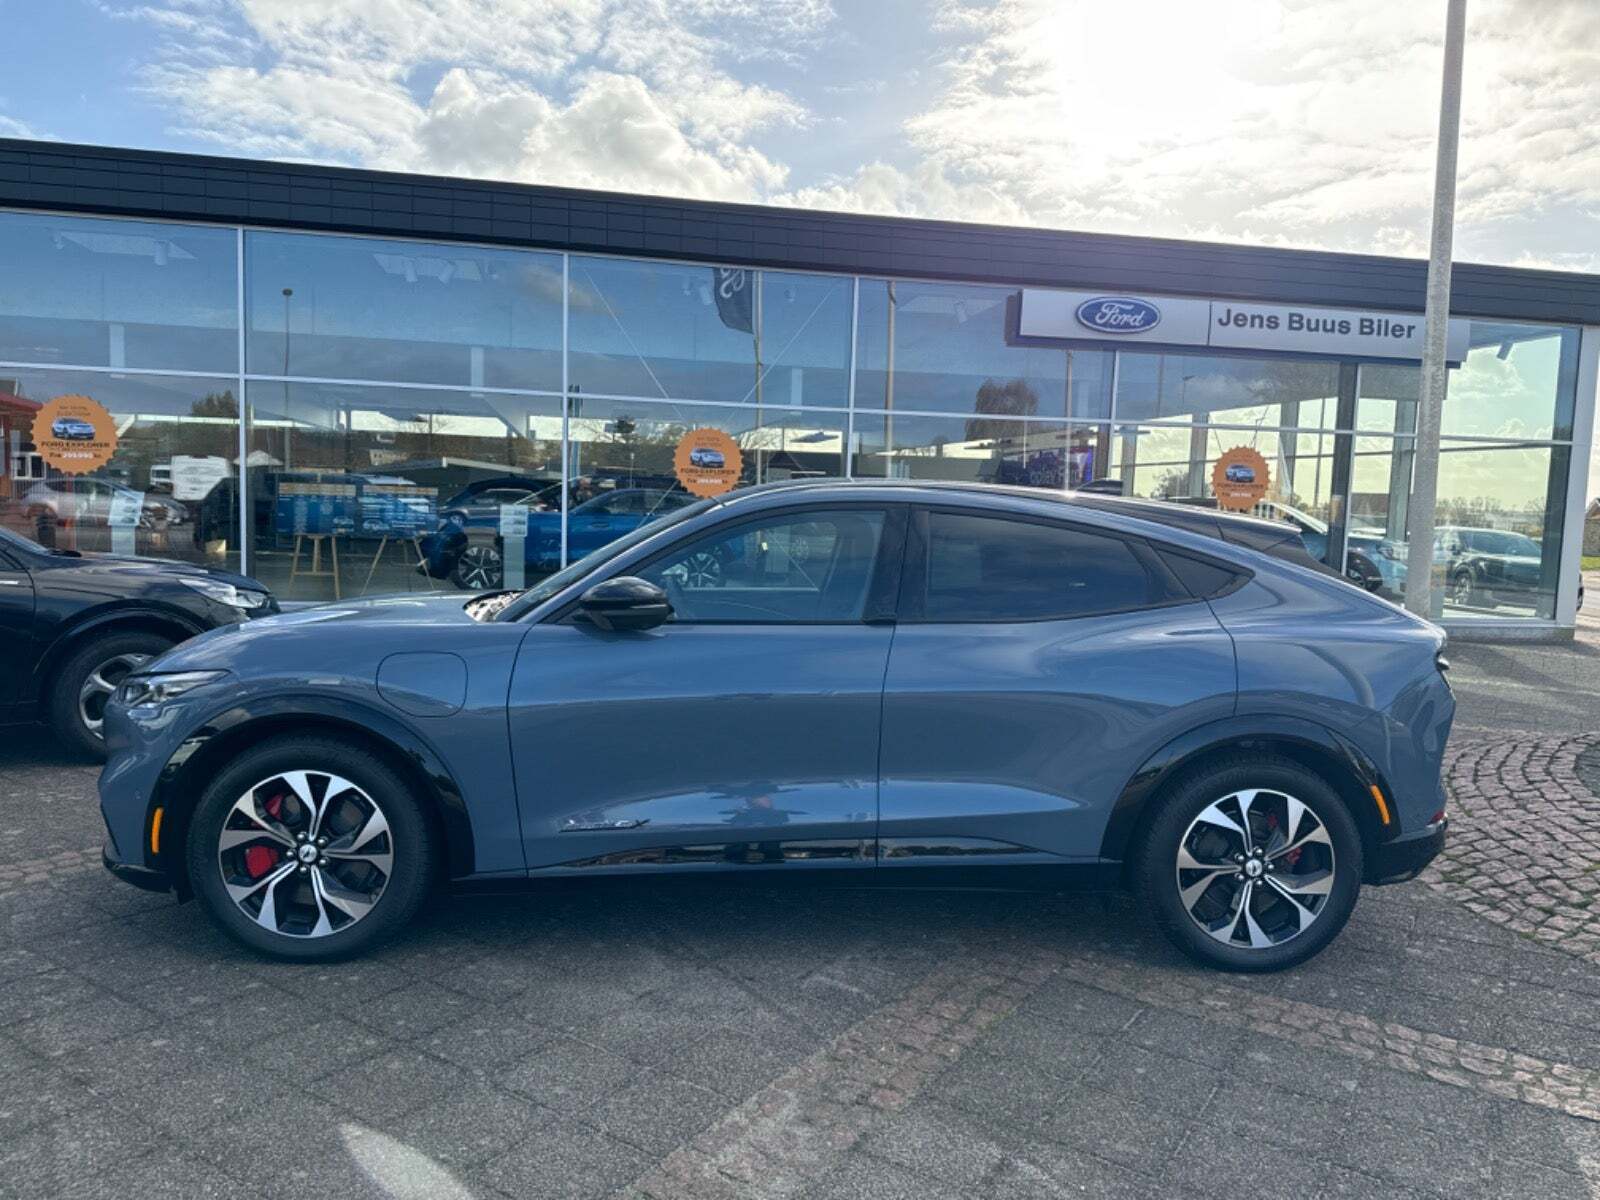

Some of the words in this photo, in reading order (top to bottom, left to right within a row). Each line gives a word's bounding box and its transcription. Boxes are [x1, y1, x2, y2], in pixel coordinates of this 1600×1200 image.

[1094, 302, 1147, 326] Ford
[1217, 308, 1280, 330] Jens
[1287, 312, 1352, 336] Buus
[1359, 317, 1416, 339] Biler
